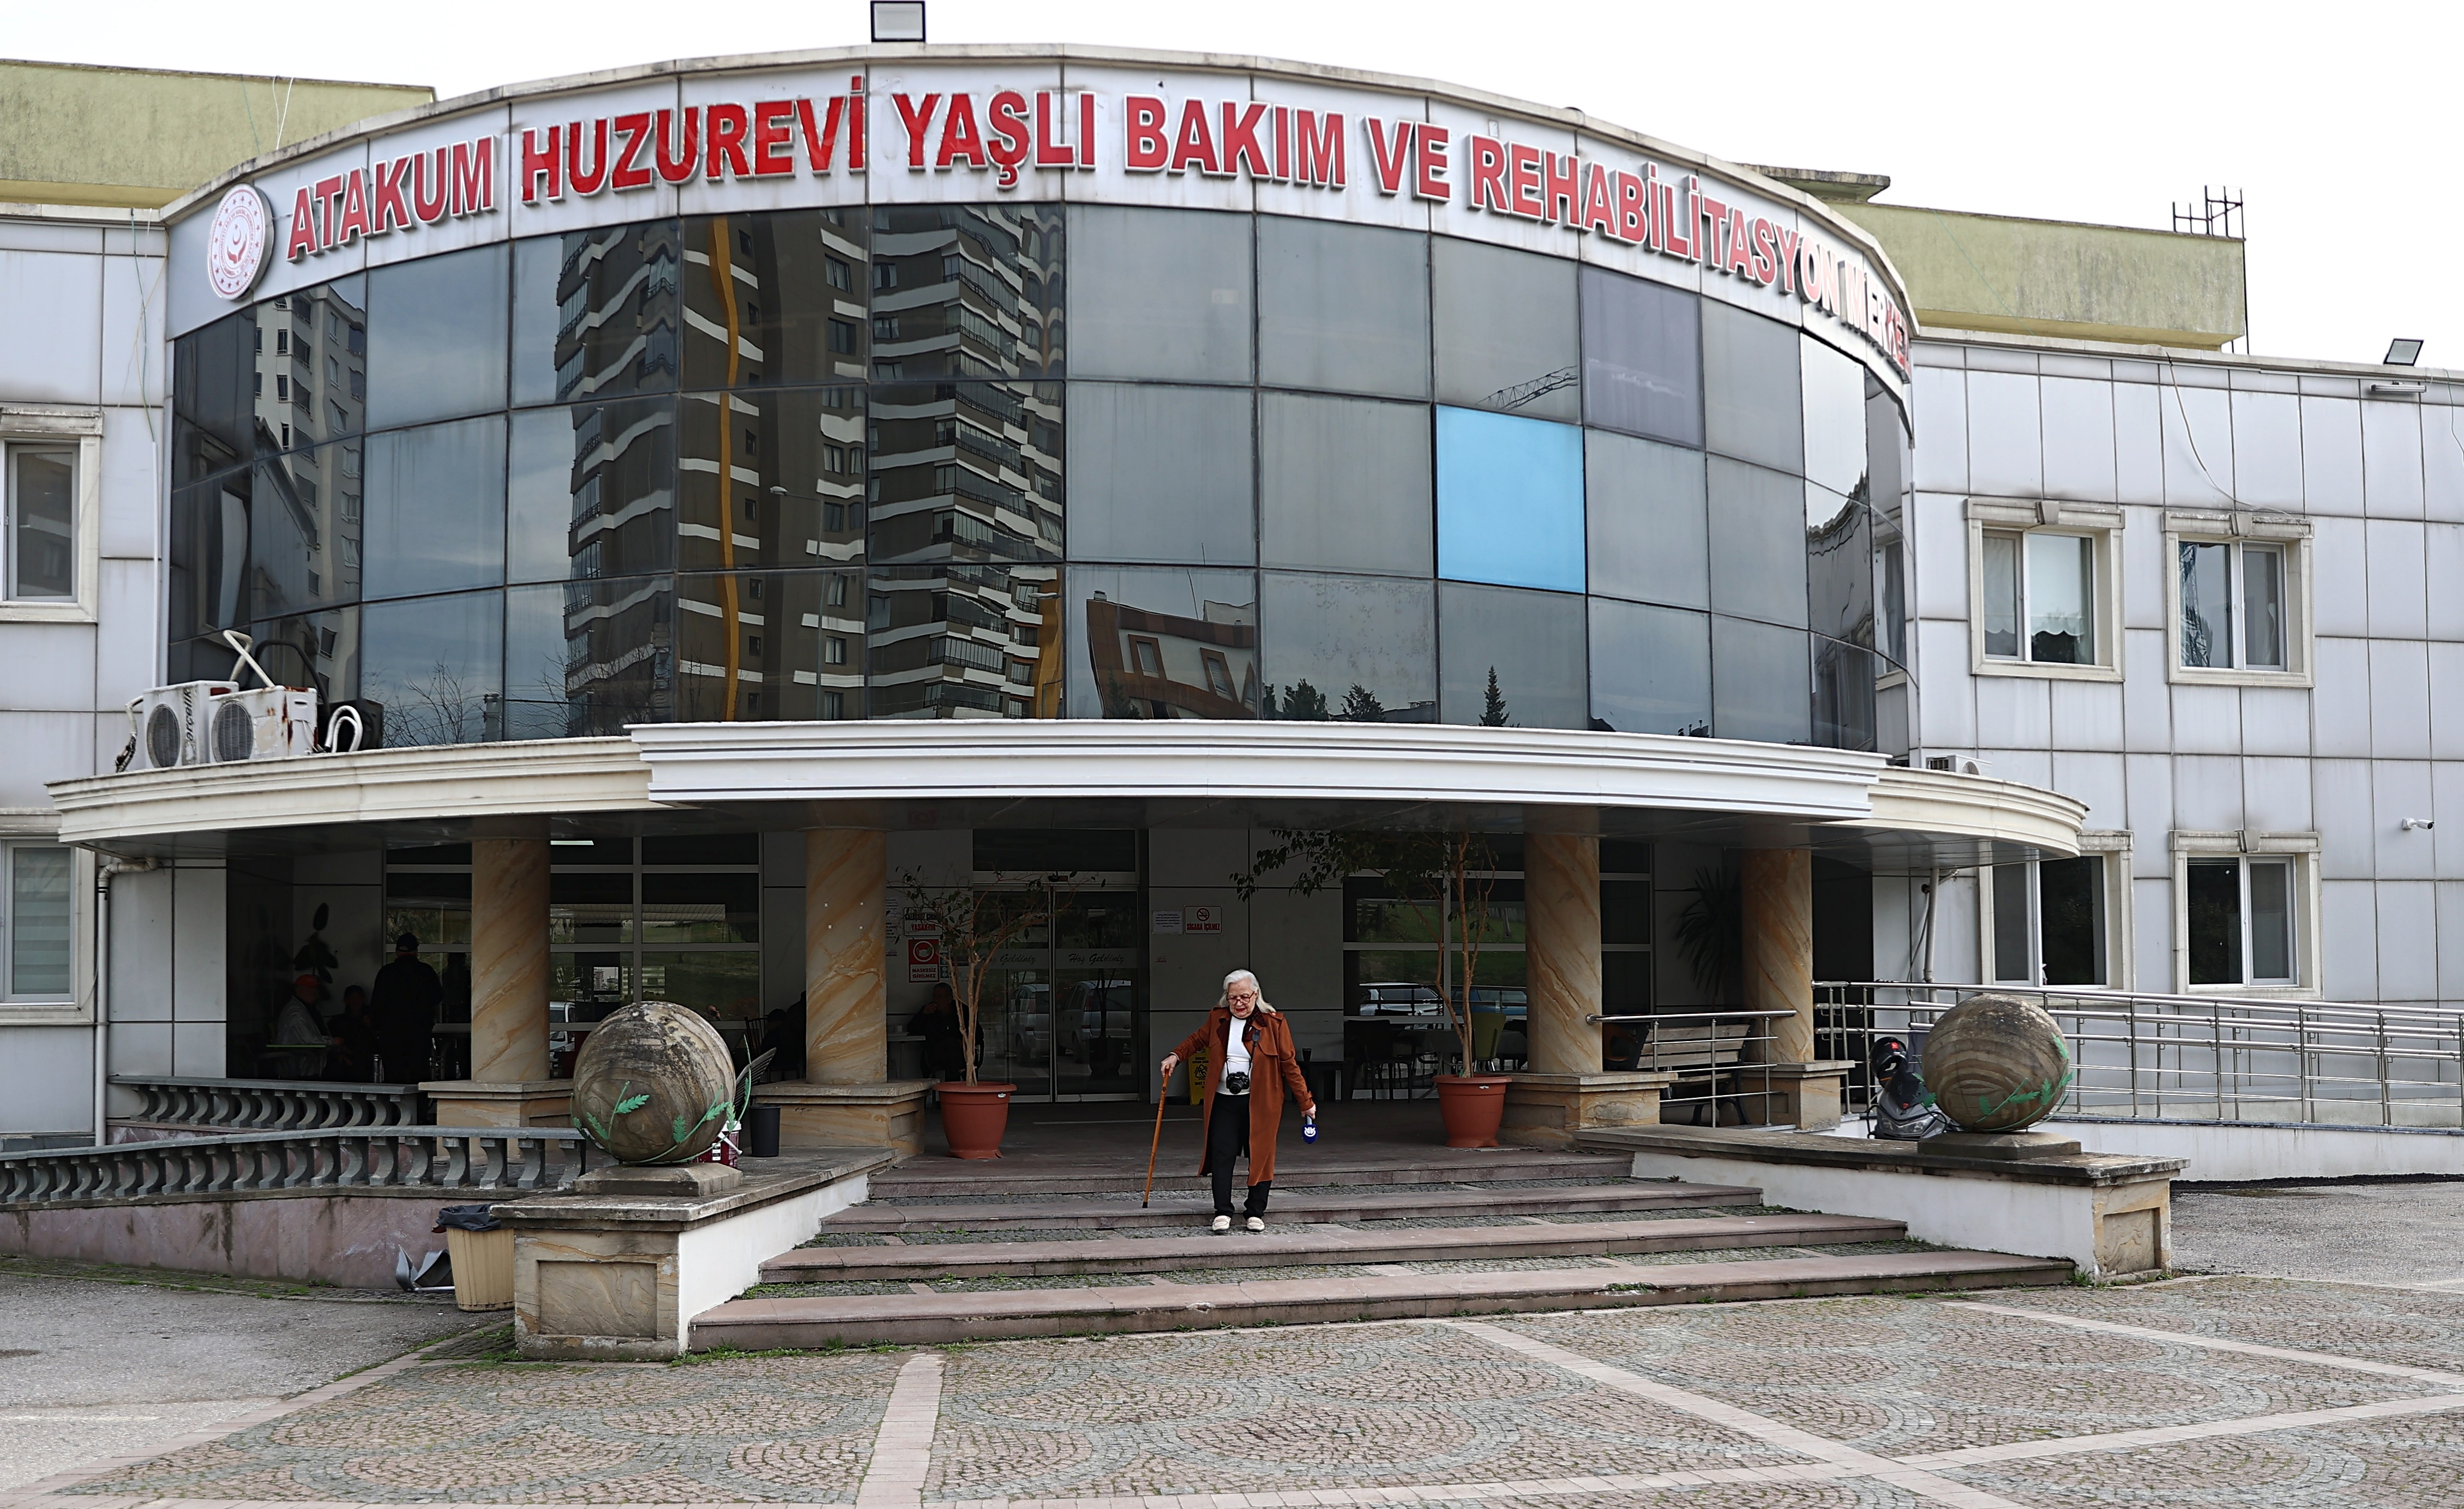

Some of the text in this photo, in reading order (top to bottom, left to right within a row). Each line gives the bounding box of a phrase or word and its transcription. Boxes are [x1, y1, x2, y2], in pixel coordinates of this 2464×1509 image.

[286, 134, 496, 262] ATAKUM
[521, 74, 867, 205] HUZUREVİ
[891, 89, 1097, 190] YAŞLI
[1123, 93, 1347, 189] BAKIM
[1364, 116, 1451, 203] VE
[1468, 133, 1840, 317] REHABİLİTASYON
[183, 688, 194, 742] arçelik
[1187, 922, 1221, 931] SİGARA İÇİLMEZ
